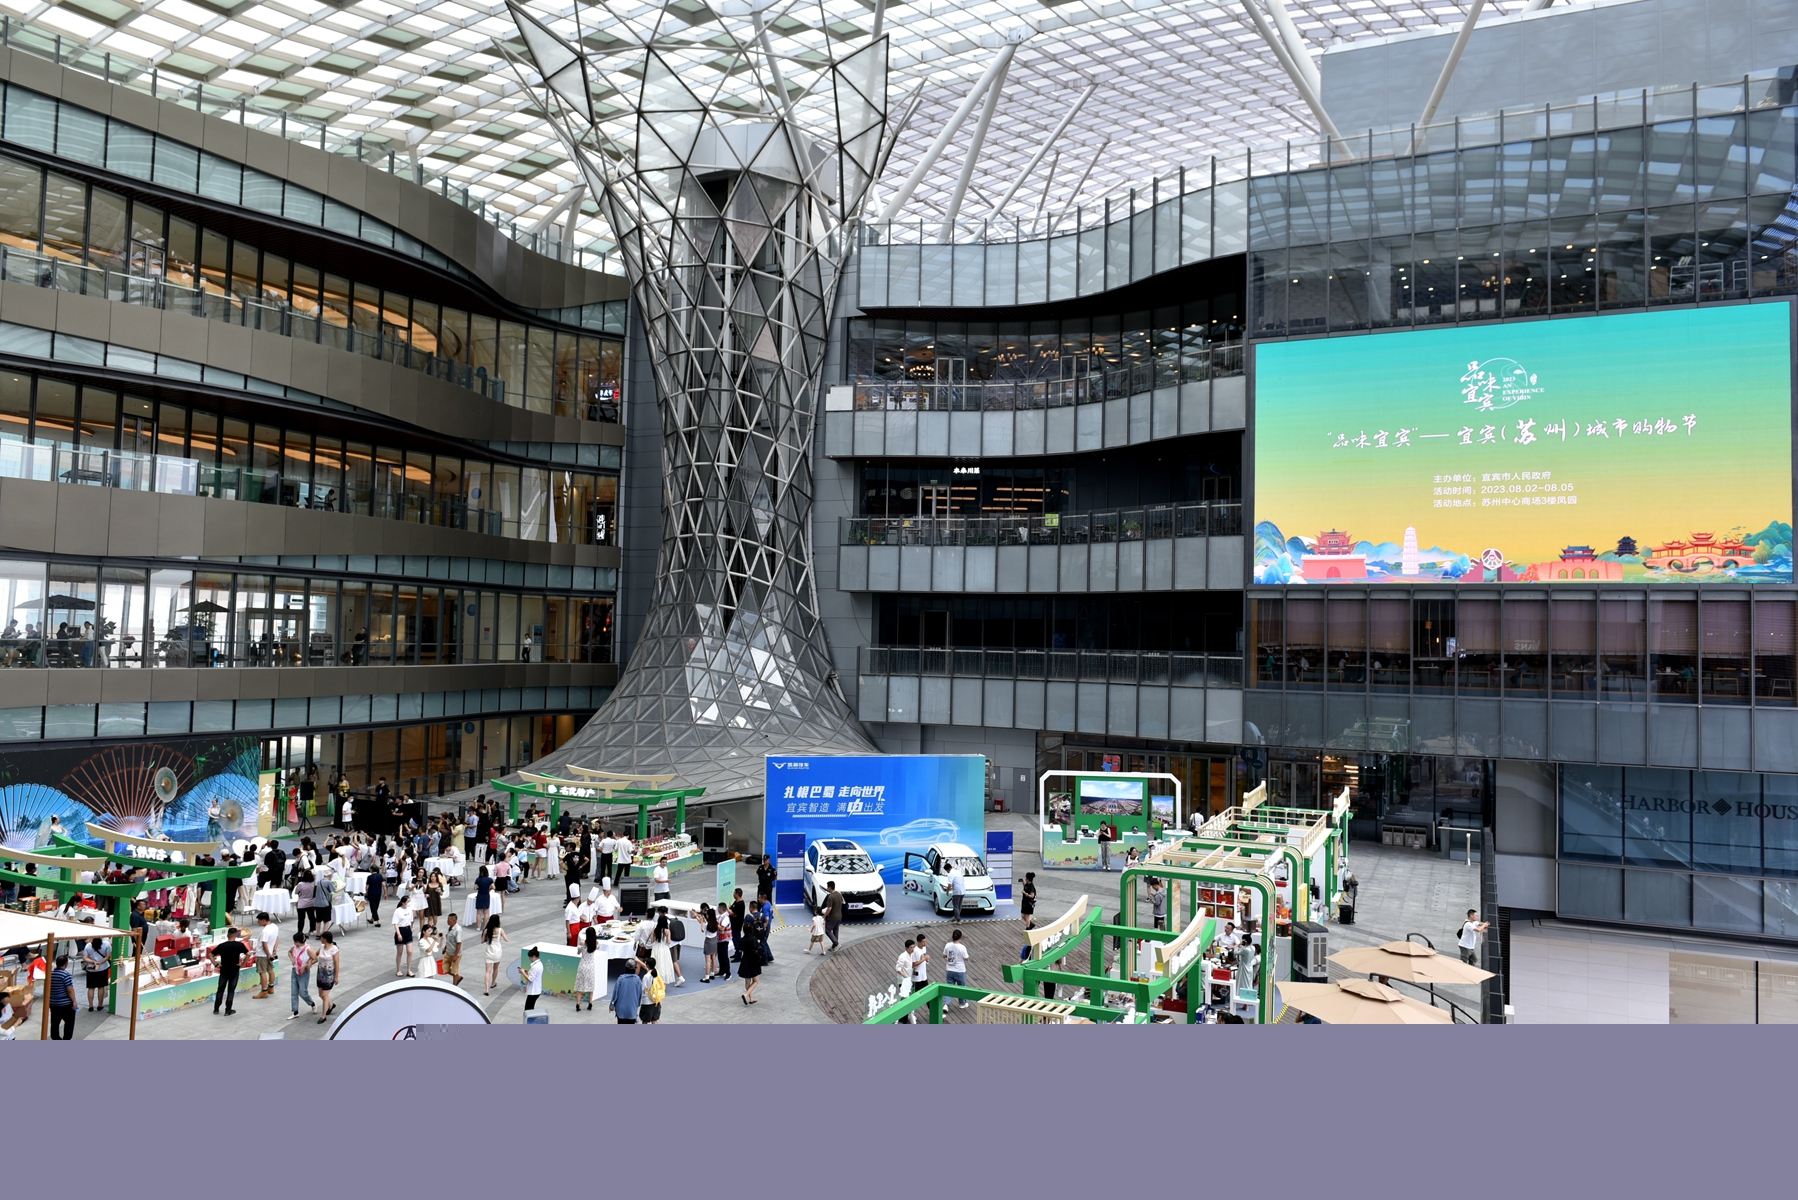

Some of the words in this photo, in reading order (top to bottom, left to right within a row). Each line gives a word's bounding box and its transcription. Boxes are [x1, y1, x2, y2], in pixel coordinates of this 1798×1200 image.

[259, 783, 272, 816] 宜宾
[783, 786, 835, 798] 扎根巴蜀
[838, 785, 885, 801] 走向世界
[785, 802, 830, 813] 宜宾智造
[1620, 795, 1711, 815] HARBOR
[386, 862, 396, 870] 23
